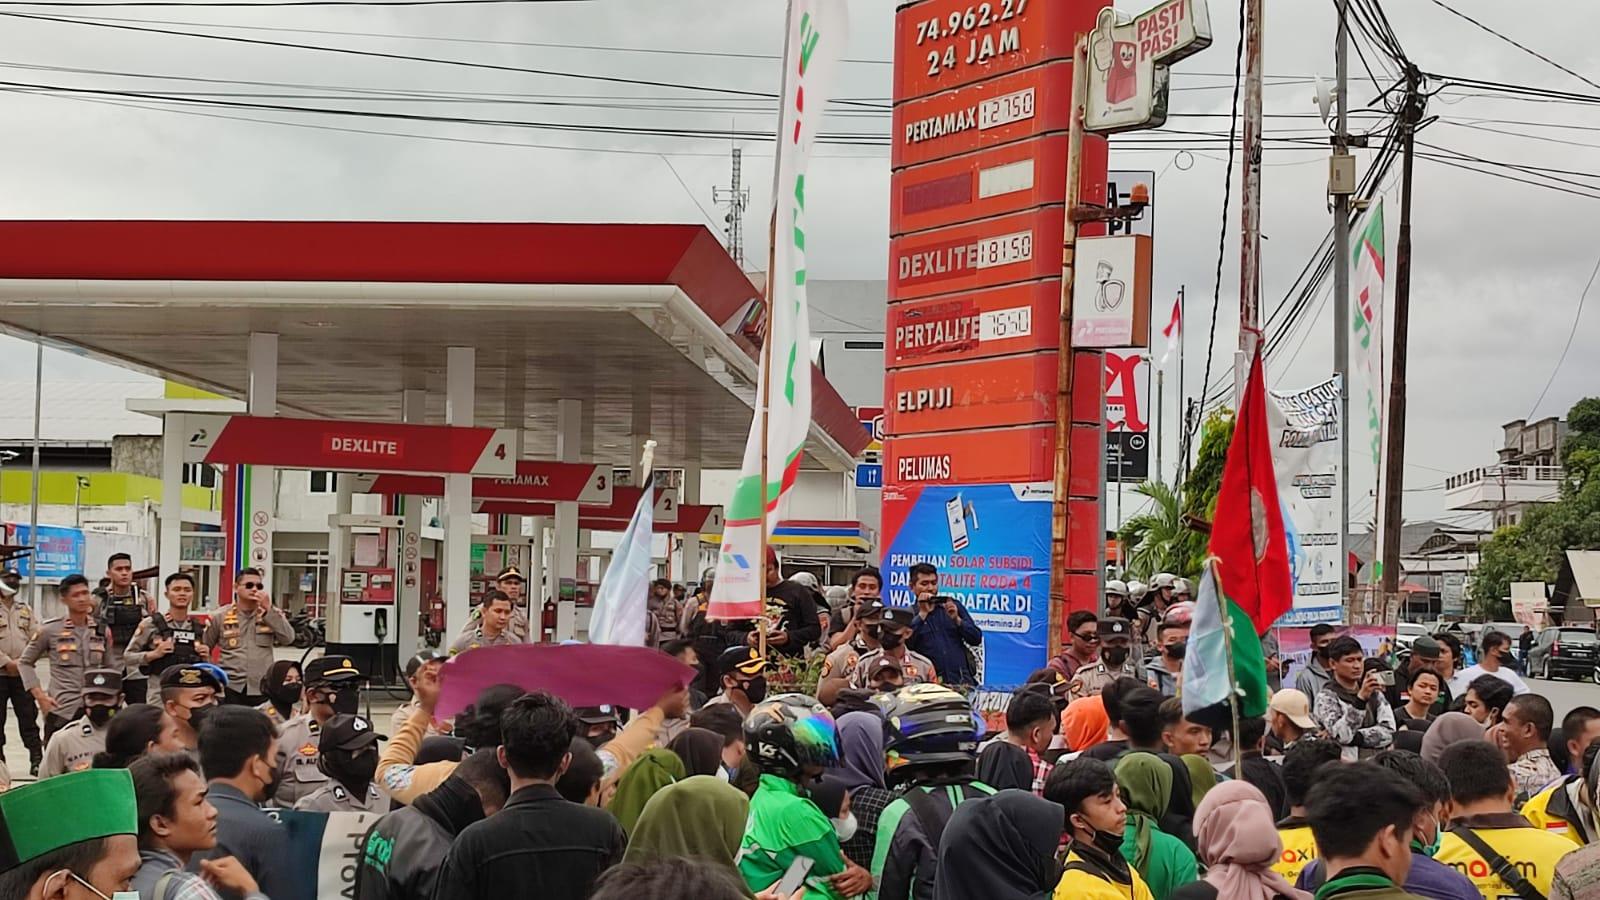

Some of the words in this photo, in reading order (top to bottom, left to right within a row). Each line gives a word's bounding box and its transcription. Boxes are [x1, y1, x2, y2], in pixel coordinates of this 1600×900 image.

[1138, 0, 1184, 41] PASTI
[927, 45, 955, 76] 24
[966, 26, 1020, 64] JAM
[1140, 25, 1178, 62] PAS!
[905, 106, 976, 143] PERTAMAX
[983, 92, 1033, 124] 12750
[899, 243, 978, 280] DEXLITE
[981, 235, 1031, 263] 18150
[896, 315, 980, 350] PERTALITE
[987, 309, 1029, 336] 7650
[897, 387, 953, 412] ELPIJI
[331, 437, 397, 455] DEXLITE
[494, 443, 506, 461] 4
[898, 455, 950, 481] PELUMAS
[596, 475, 606, 491] 3
[663, 498, 672, 511] 2
[713, 514, 719, 525] 1
[950, 556, 985, 568] SOLAR
[989, 557, 1032, 569] SUBSIDI
[938, 573, 976, 588] TALITE
[980, 575, 1017, 590] RODA
[1022, 575, 1031, 589] 4
[1015, 594, 1032, 612] DI
[1280, 842, 1316, 863] axi
